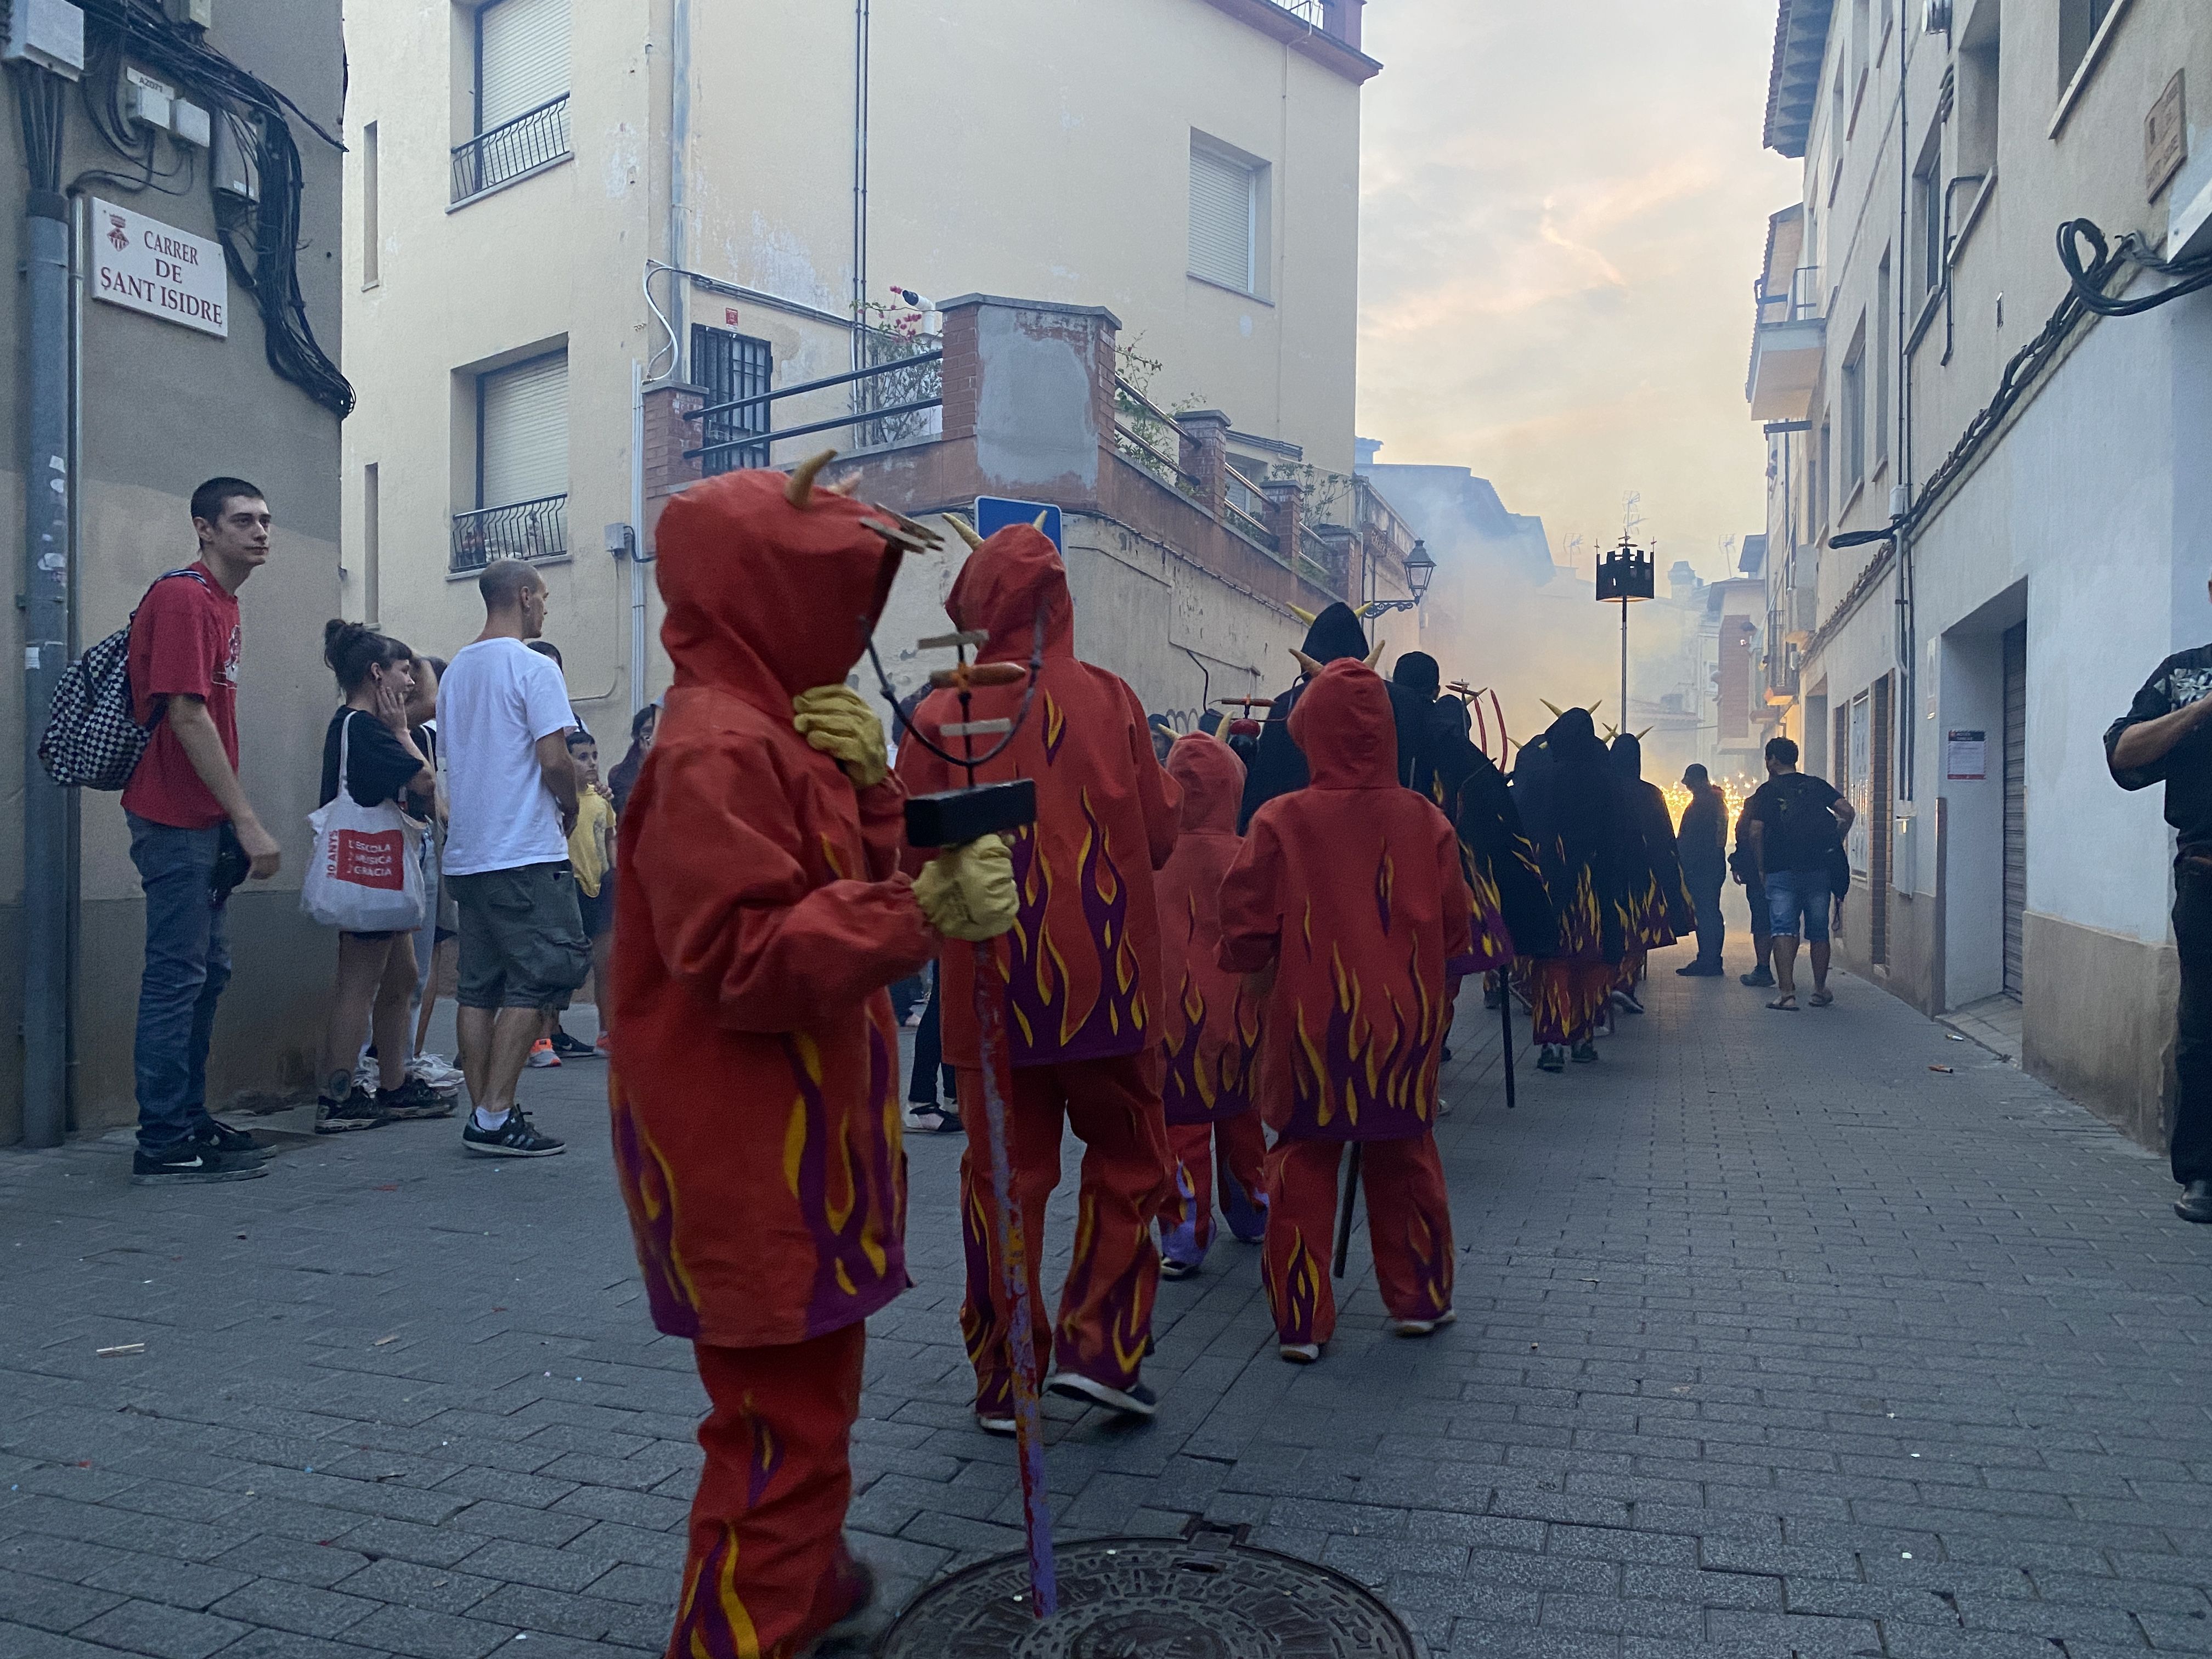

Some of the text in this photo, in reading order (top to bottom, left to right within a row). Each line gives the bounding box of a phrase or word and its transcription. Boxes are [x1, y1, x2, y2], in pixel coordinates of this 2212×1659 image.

[144, 230, 199, 266] CARRER
[155, 258, 182, 284] DE
[100, 267, 222, 325] SANT ISIDRE
[328, 830, 338, 861] ANYS
